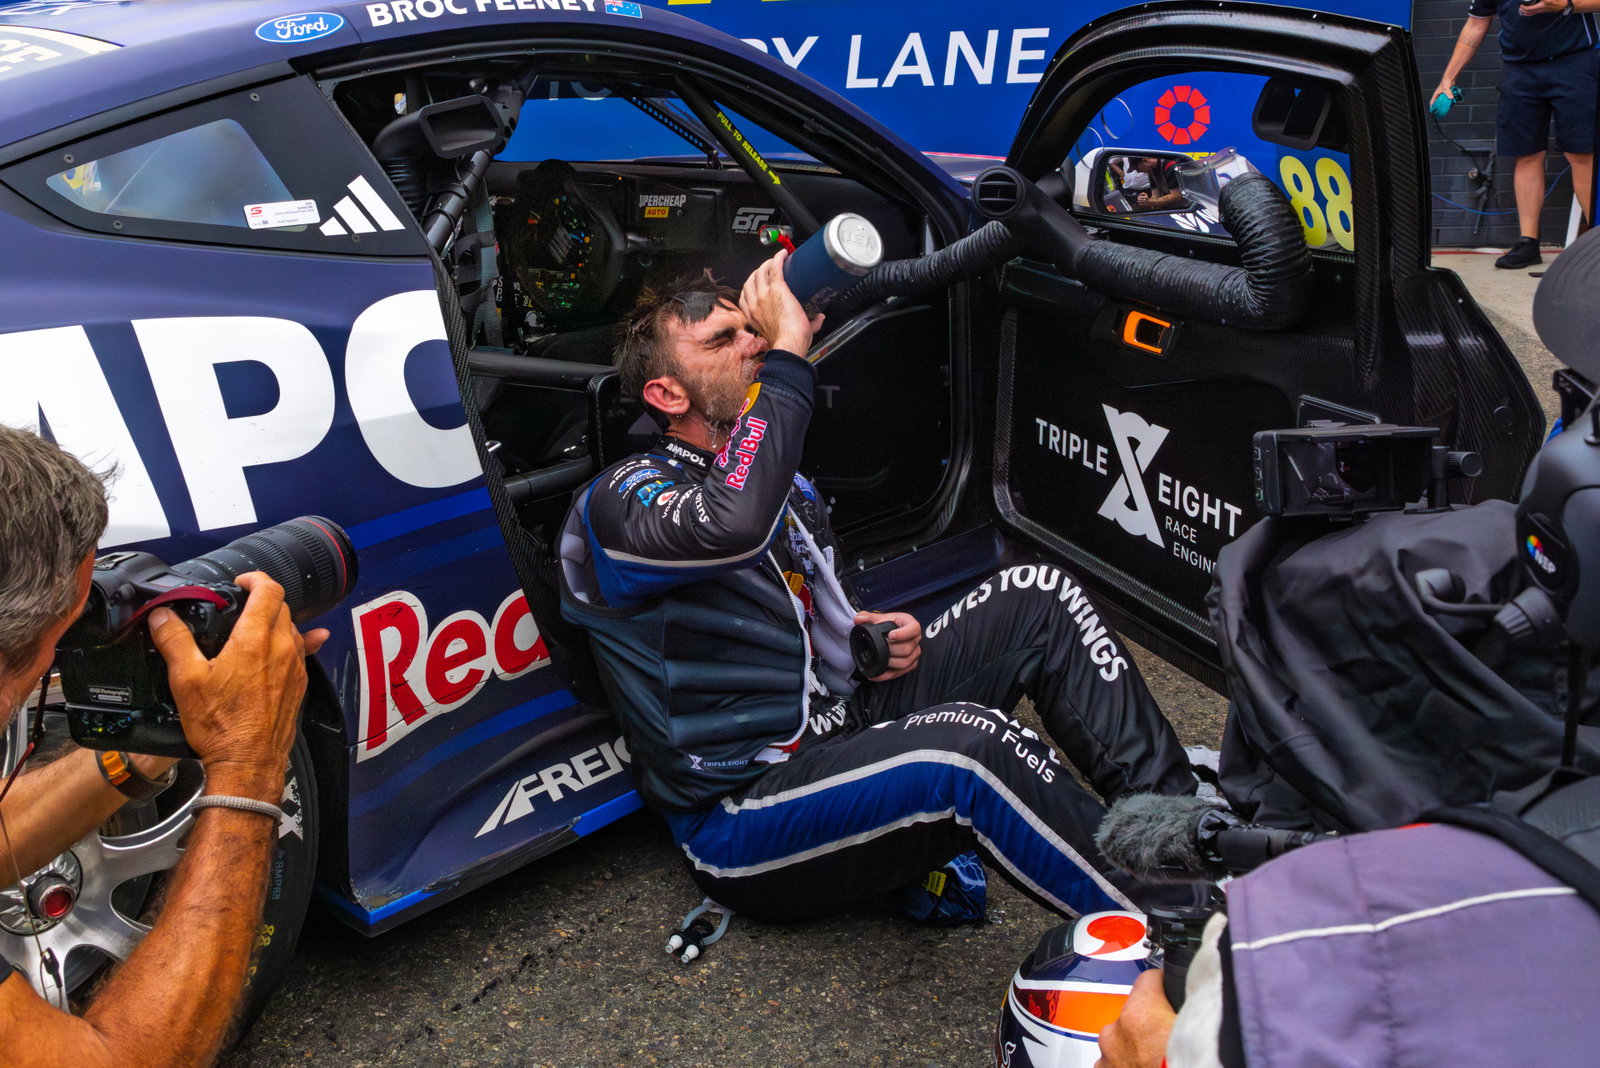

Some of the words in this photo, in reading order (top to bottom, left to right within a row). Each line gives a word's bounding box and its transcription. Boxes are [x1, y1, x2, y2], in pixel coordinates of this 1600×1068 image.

[272, 15, 332, 41] Ford
[365, 0, 467, 28] BROC
[846, 28, 1050, 89] LANE
[717, 111, 732, 131] PULL
[733, 129, 743, 141] TO
[742, 140, 768, 172] RELEASE
[646, 208, 667, 216] AUTO
[1280, 155, 1354, 251] 88
[666, 443, 707, 467] AMPOL
[724, 448, 754, 490] Red
[739, 416, 769, 454] Bull
[1035, 417, 1109, 477] TRIPLE
[1157, 472, 1242, 537] EIGHT
[1165, 515, 1197, 544] RACE
[925, 577, 992, 639] GIVES
[999, 564, 1061, 592] YOU
[1058, 576, 1129, 683] WINGS
[903, 709, 997, 734] Premium
[1001, 728, 1056, 784] Fuels
